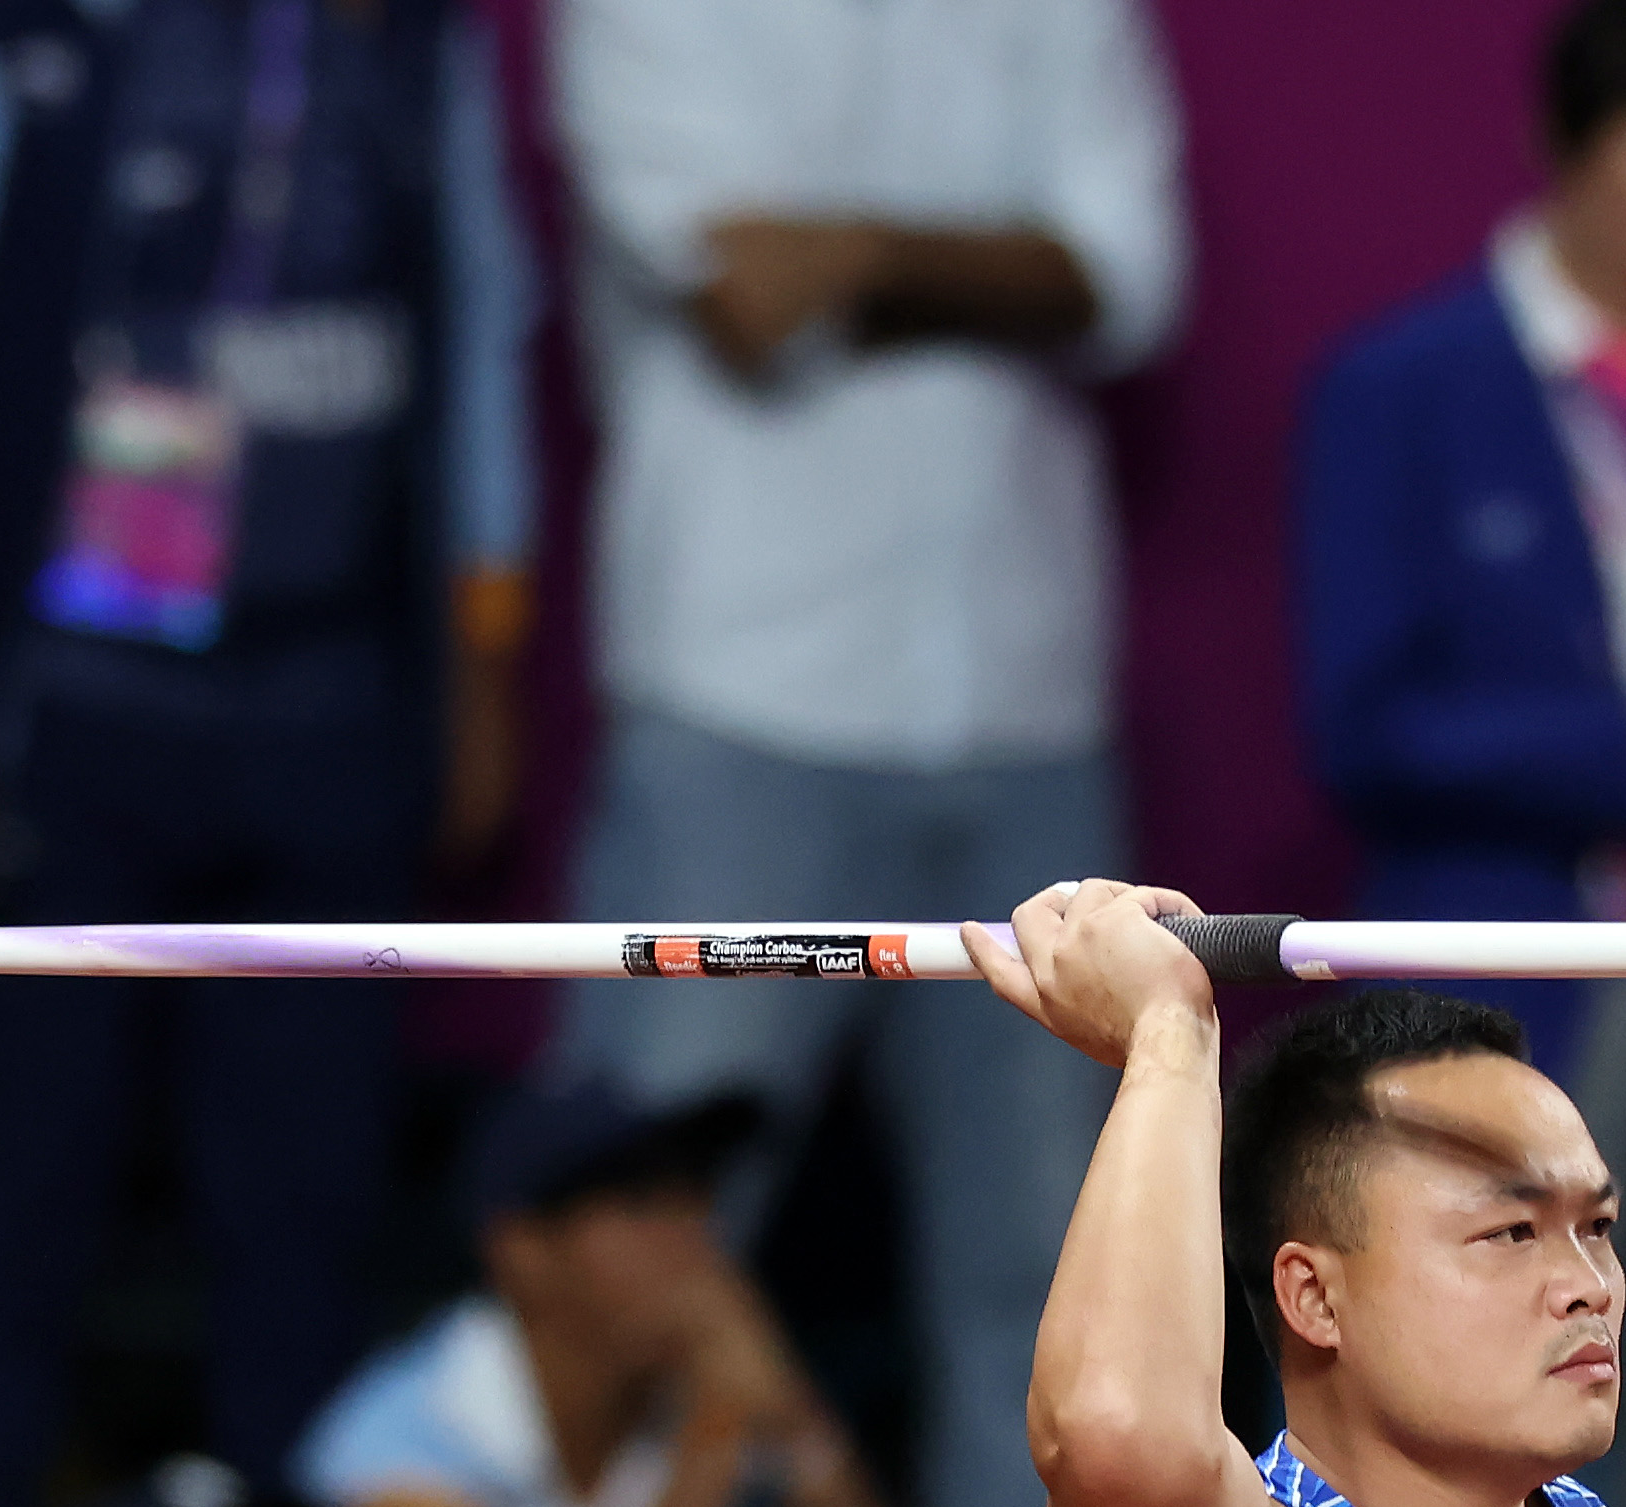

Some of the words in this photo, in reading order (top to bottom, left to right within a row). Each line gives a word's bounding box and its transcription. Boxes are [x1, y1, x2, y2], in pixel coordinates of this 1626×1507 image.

[709, 940, 763, 961] Champion
[765, 940, 804, 956] Carbon
[821, 956, 859, 971] IAAF
